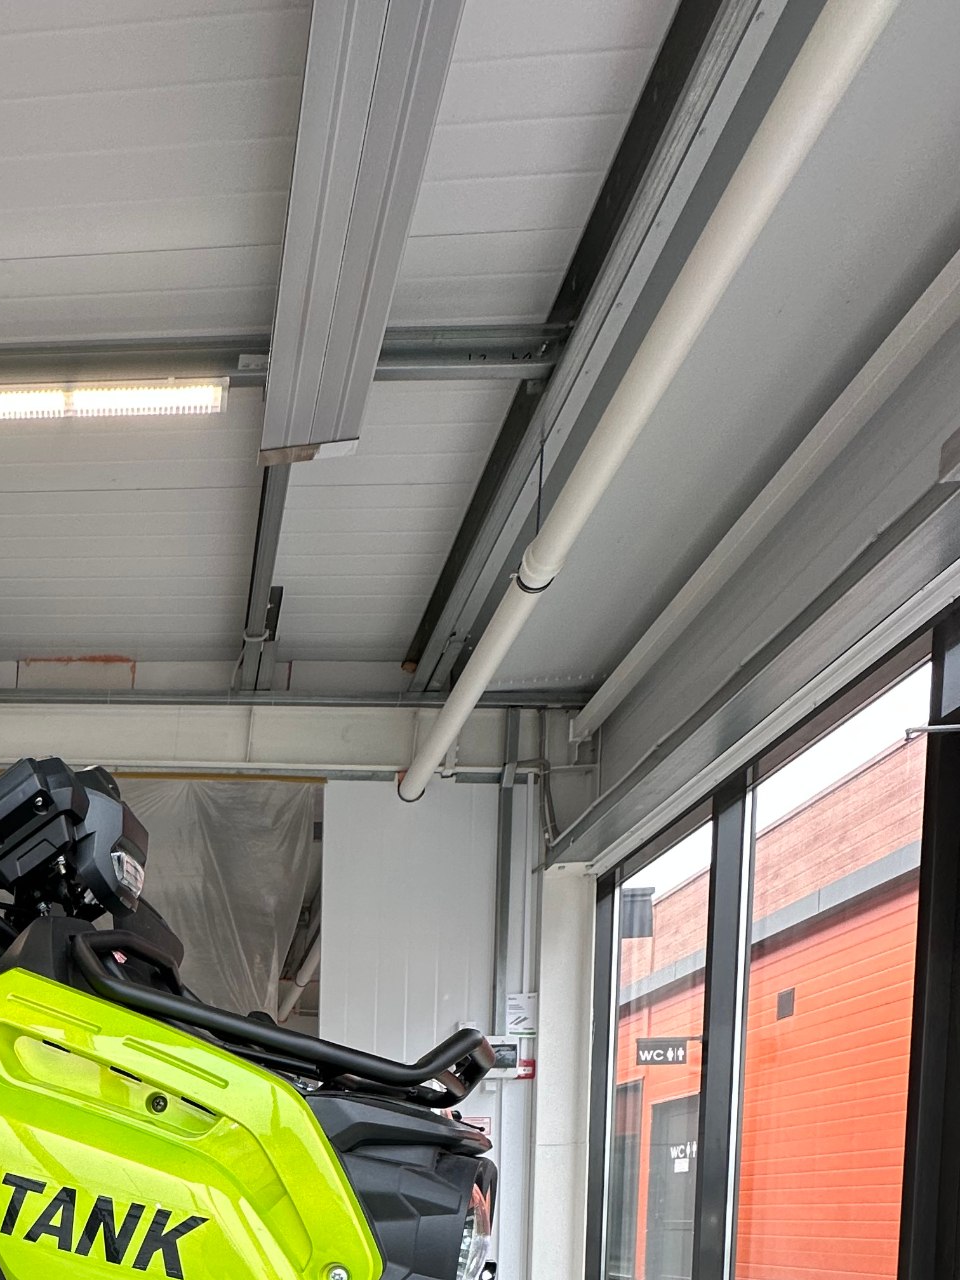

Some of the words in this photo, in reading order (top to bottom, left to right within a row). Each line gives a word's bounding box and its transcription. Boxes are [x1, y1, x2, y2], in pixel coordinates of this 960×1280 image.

[639, 1049, 665, 1061] WC
[670, 1144, 686, 1159] WC
[0, 1172, 210, 1280] TANK
